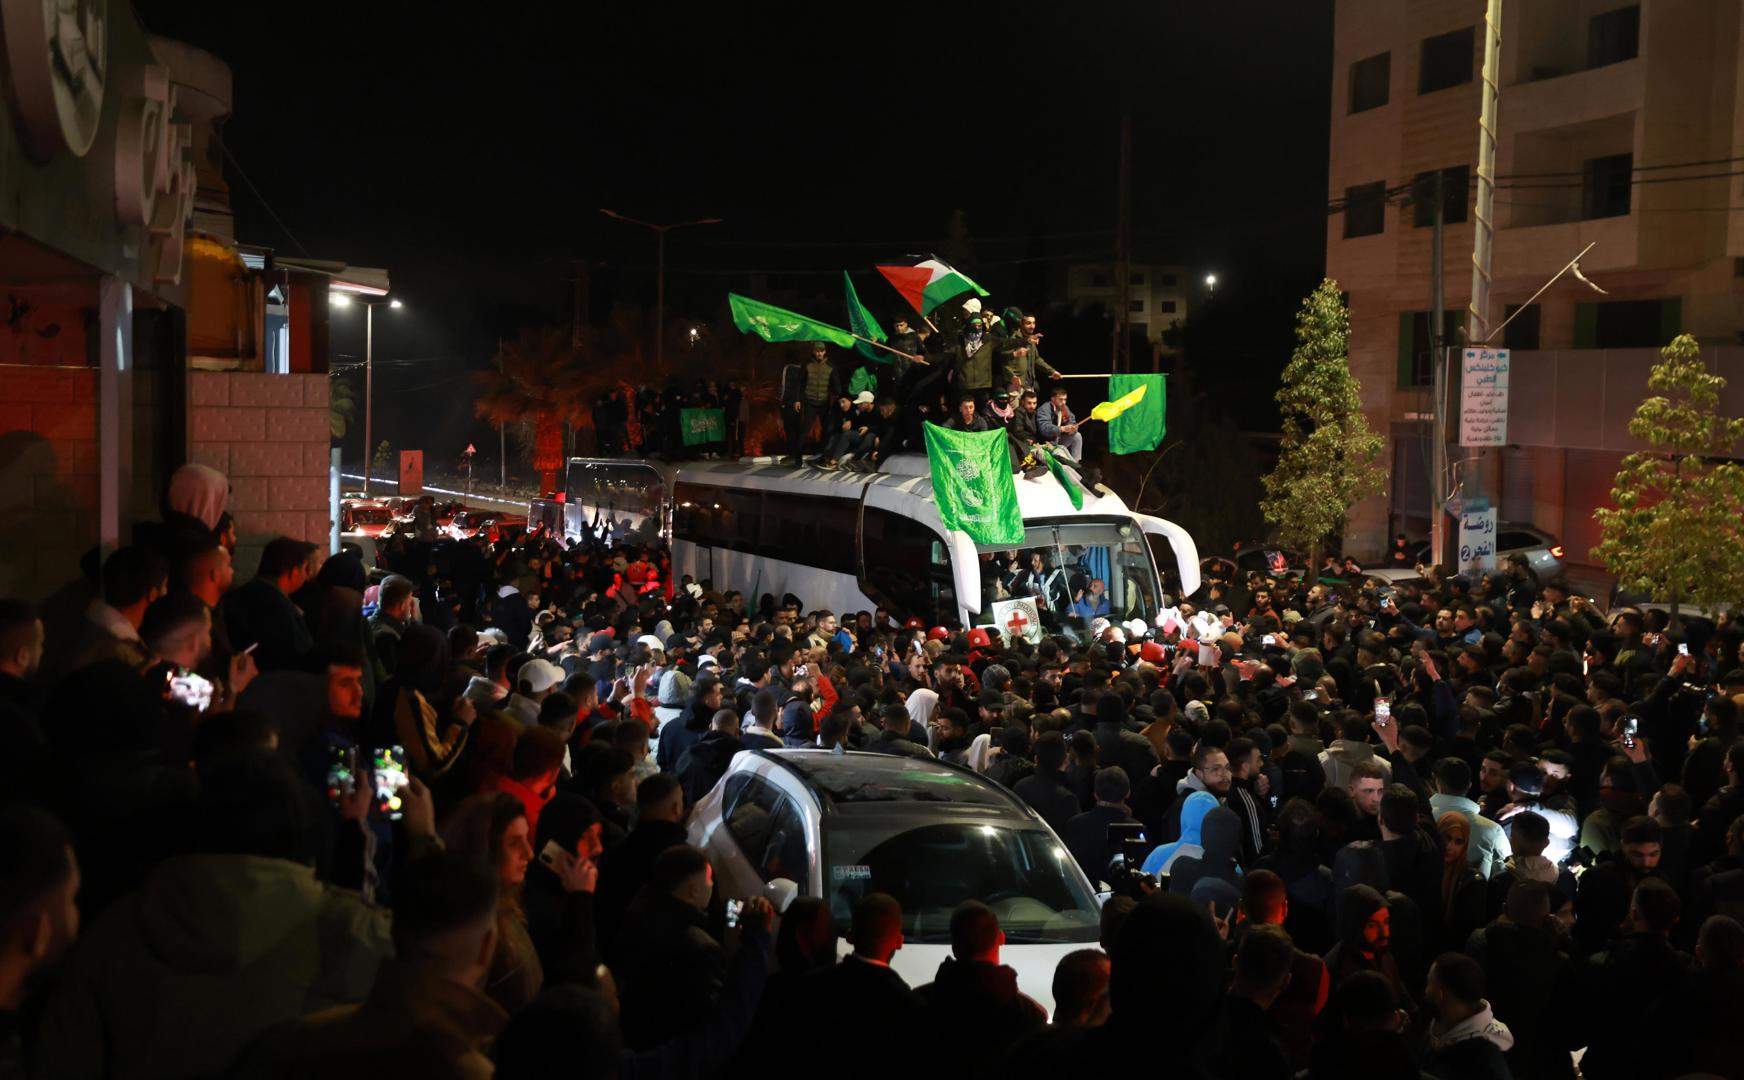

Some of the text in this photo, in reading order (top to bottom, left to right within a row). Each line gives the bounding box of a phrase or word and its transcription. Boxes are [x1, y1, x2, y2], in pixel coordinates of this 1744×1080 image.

[1479, 350, 1495, 360] مركز
[1476, 374, 1497, 385] الطبي
[1463, 512, 1494, 534] روضة
[1472, 540, 1495, 560] الفجر
